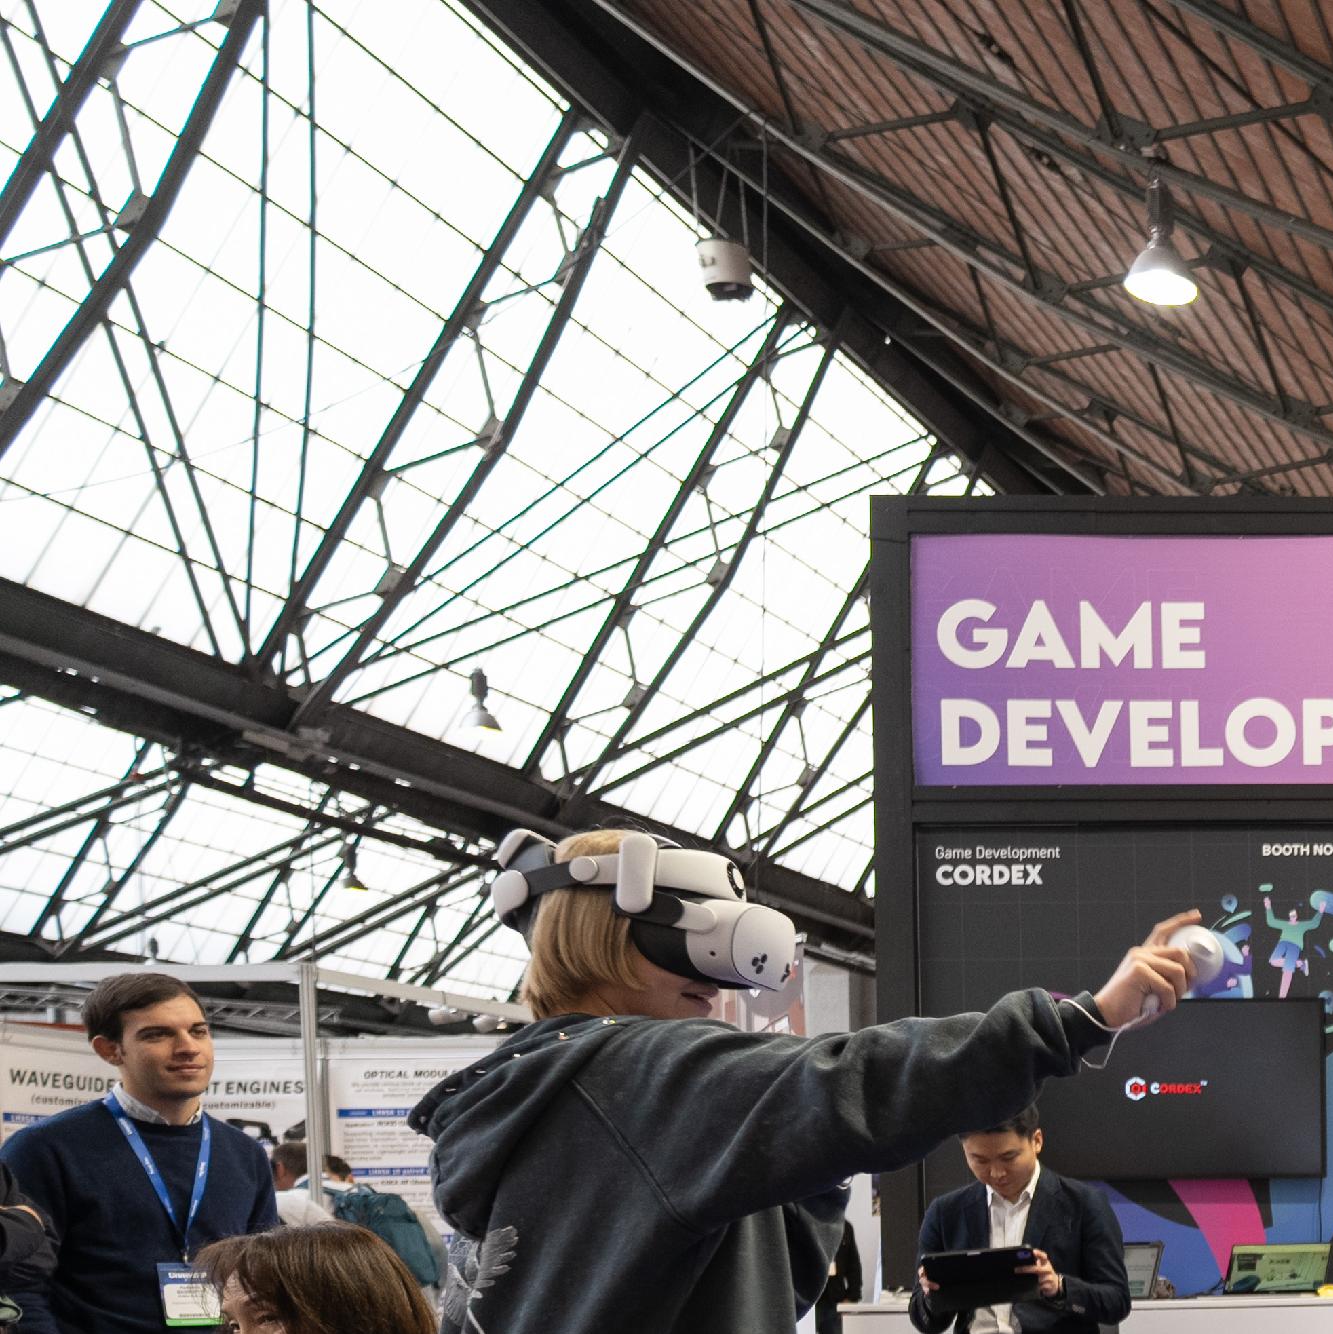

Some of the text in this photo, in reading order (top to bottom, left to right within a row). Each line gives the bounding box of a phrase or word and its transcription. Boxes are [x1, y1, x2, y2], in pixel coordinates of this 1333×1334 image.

[937, 599, 1206, 669] GAME
[935, 845, 1061, 862] Game Development
[1262, 843, 1309, 857] BOOTH
[1312, 843, 1333, 857] NO
[935, 863, 1044, 886] CORDEX
[363, 1070, 409, 1080] OPTICAL
[226, 1080, 305, 1095] ENGINES
[1150, 1082, 1201, 1095] CORDEX
